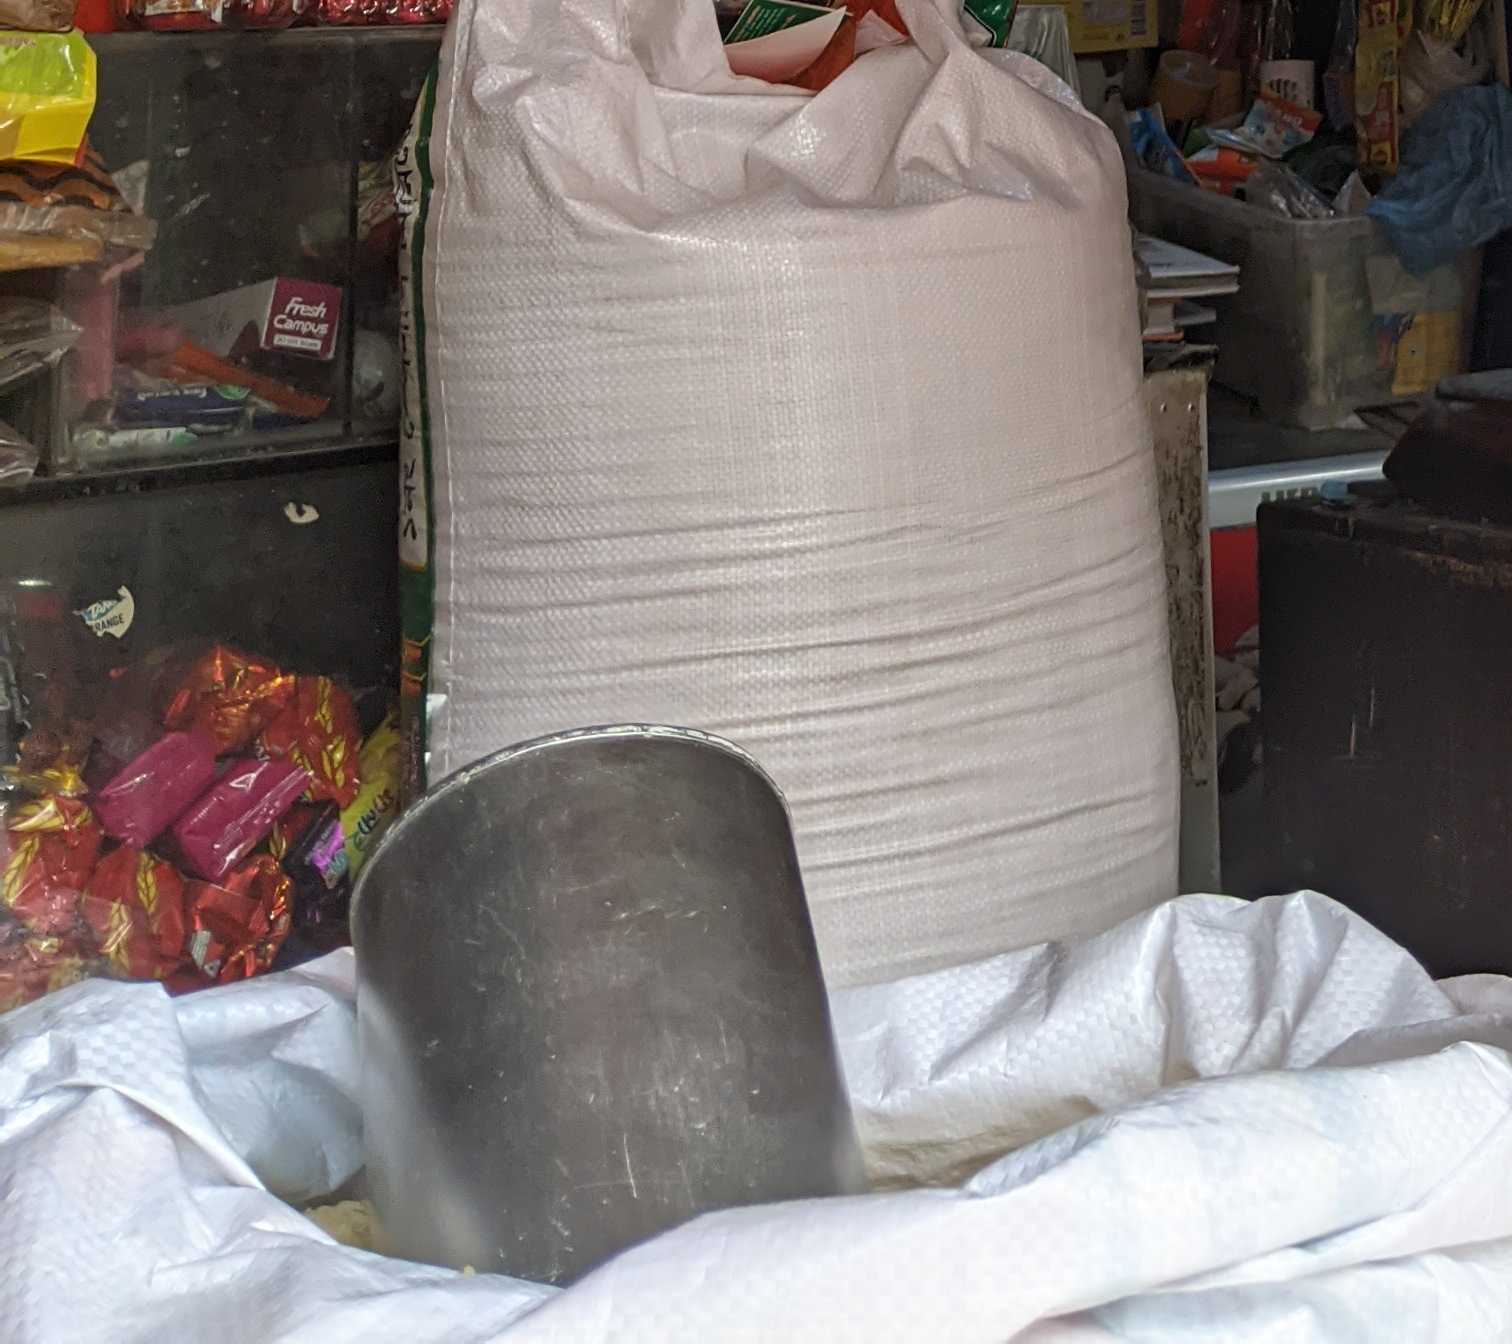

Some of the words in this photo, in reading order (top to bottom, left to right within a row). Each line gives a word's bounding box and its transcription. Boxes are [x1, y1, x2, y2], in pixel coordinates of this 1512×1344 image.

[285, 297, 326, 320] Fresh
[273, 313, 329, 337] Campus
[93, 613, 125, 634] RANGE
